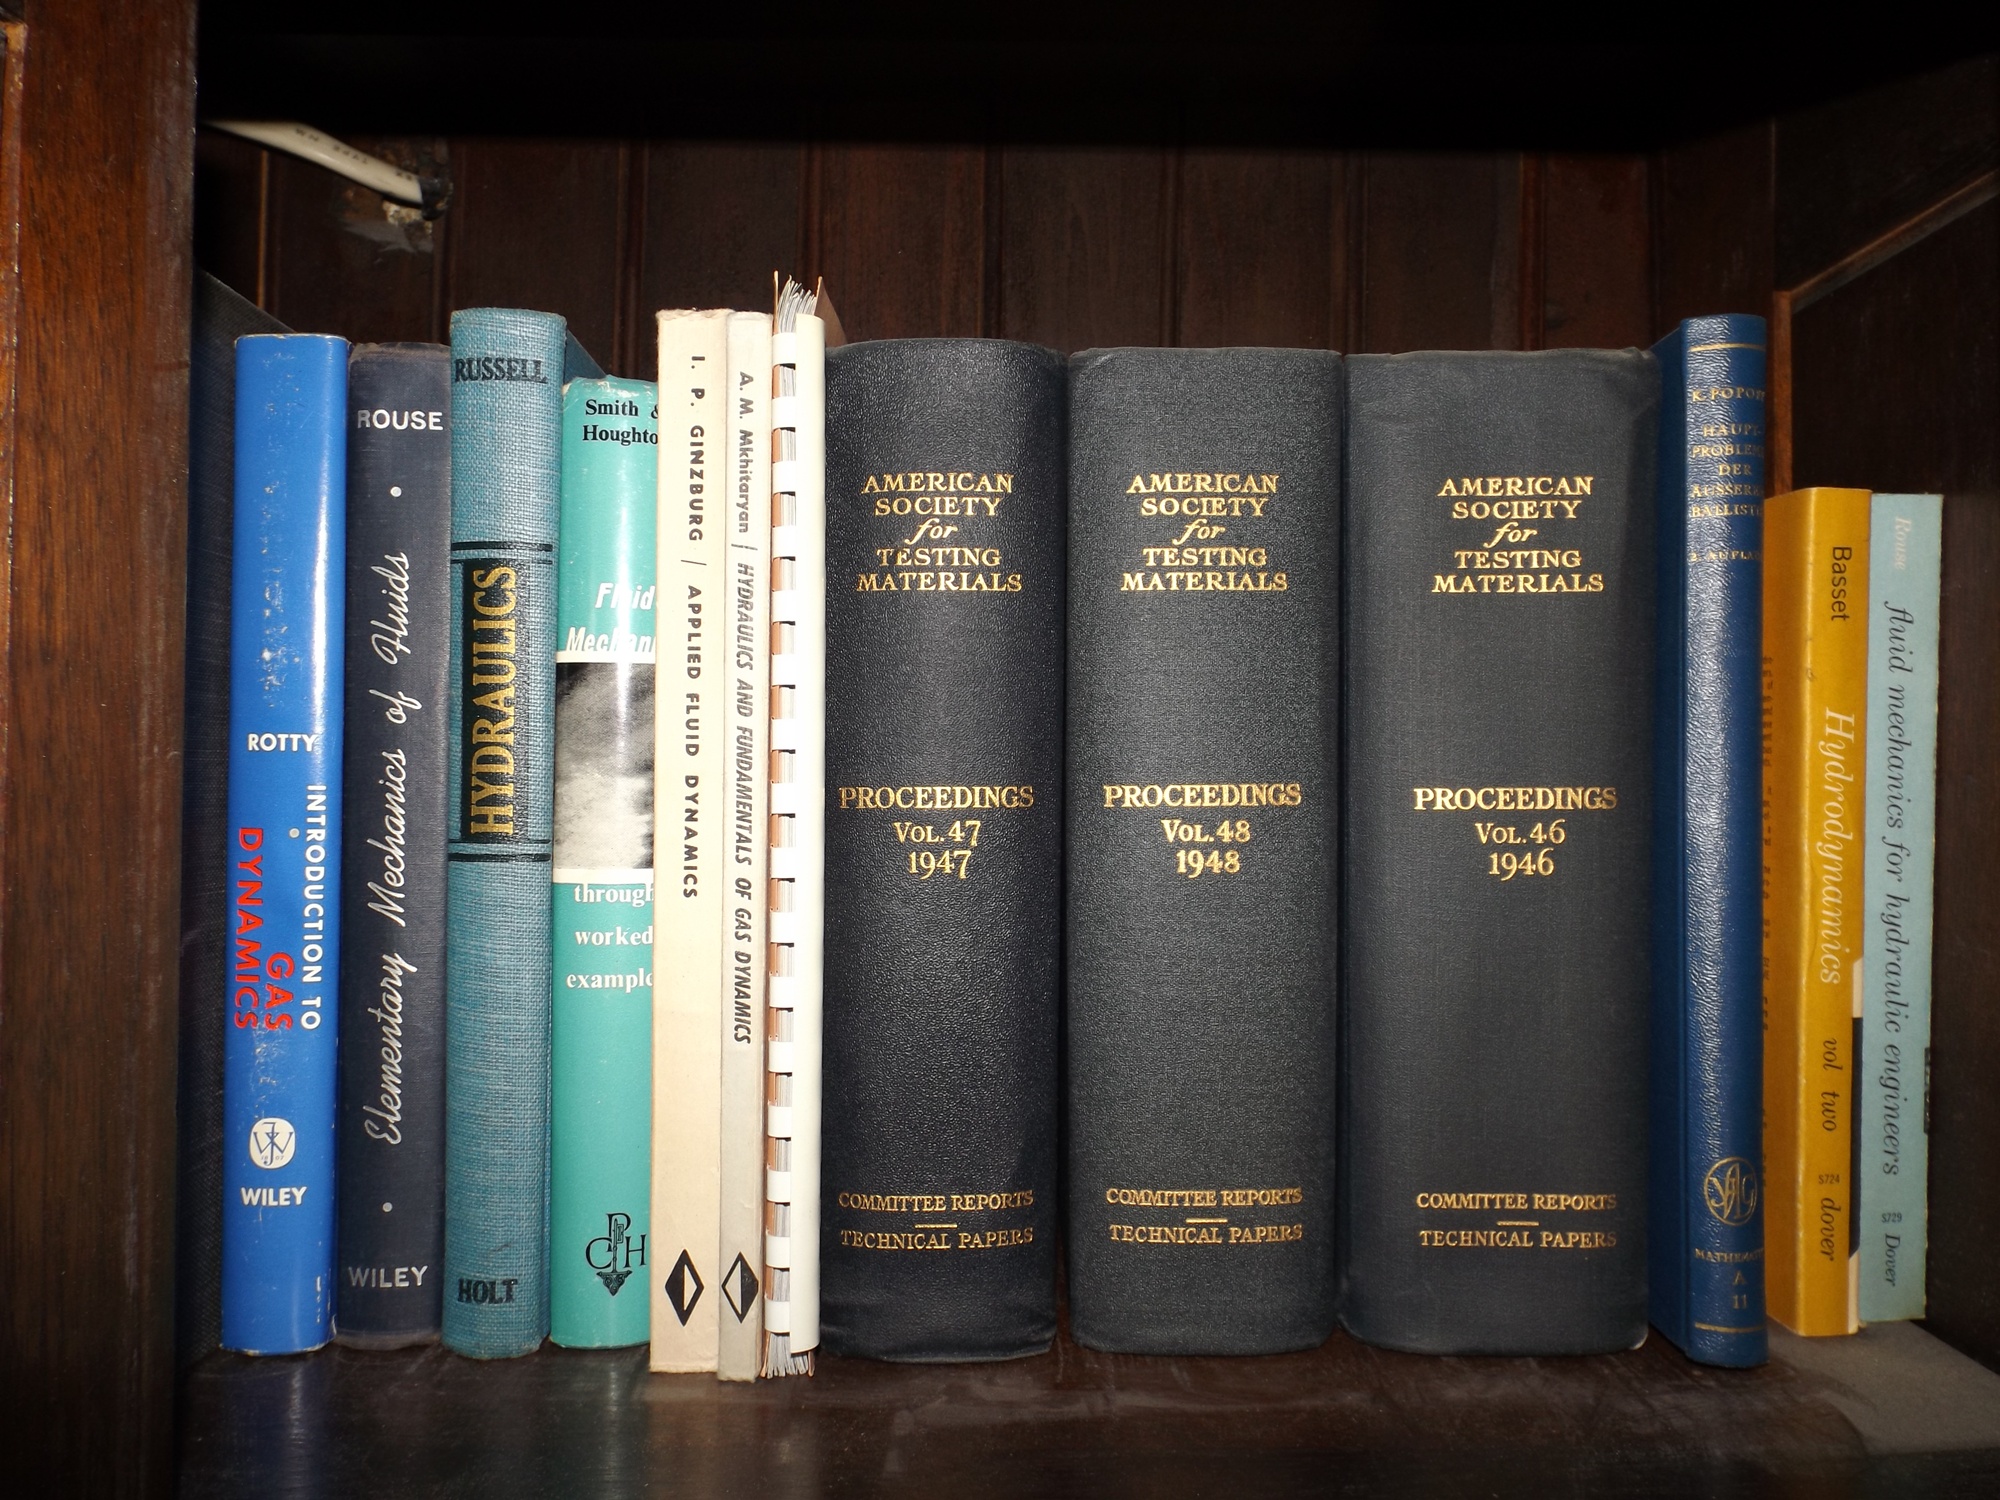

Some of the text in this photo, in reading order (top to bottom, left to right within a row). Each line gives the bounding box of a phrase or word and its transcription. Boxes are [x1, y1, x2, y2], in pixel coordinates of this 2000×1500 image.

[455, 357, 548, 384] RUSSELL
[585, 399, 639, 416] Smith
[357, 409, 444, 430] ROUSE
[738, 371, 754, 534] A. M. Mkhitaryan
[1692, 444, 1765, 458] PROBLEM
[1718, 463, 1752, 476] DER
[688, 425, 705, 541] GINZBURG
[861, 472, 1014, 494] AMERICAN
[1126, 473, 1279, 494] AMERICAN
[1437, 476, 1593, 497] AMERICAN
[874, 496, 1003, 516] SOCIETY
[1141, 497, 1269, 517] SOCIETY
[1452, 500, 1582, 519] SOCIETY
[1691, 503, 1763, 518] BALLISTI
[904, 517, 958, 545] for
[1172, 518, 1225, 545] for
[1483, 521, 1538, 549] for
[1893, 516, 1912, 571] Rouse
[876, 547, 1002, 567] TESTING
[1143, 547, 1268, 567] TESTING
[1454, 550, 1582, 570] TESTING
[856, 571, 1023, 592] MATERIALS
[1120, 571, 1288, 592] MATERIALS
[1432, 573, 1604, 593] MATERIALS
[1831, 546, 1853, 621] Basset
[470, 566, 518, 836] HYDRAULICS
[248, 733, 318, 751] ROTTY
[683, 584, 702, 898] APPLIED FLUID DYNAMICS
[734, 562, 754, 1044] HYDRAULICS AND FUNDAMENTALS OF GAS DYNAMICS
[838, 785, 1034, 809] PROCEEDINGS
[1103, 783, 1302, 808] PROCEEDINGS
[1413, 787, 1618, 810] PROCEEDINGS
[363, 552, 422, 1145] Elementary Mechanics of Fluids
[908, 850, 972, 880] 1947
[1176, 850, 1240, 879] 1948
[1489, 848, 1555, 881] 1946
[1879, 601, 1914, 1175] fluid mechanics for hydraulic engineers
[300, 785, 327, 1029] INTRODUCTION TO
[234, 827, 264, 1029] DYNAMICS
[1817, 707, 1855, 1131] Hydrodynamics vol two
[575, 926, 653, 945] worked
[264, 952, 295, 1030] GAS
[1818, 1174, 1841, 1185] S724
[241, 1186, 307, 1206] WILEY
[838, 1190, 1034, 1212] COMMITTEE REPORTS
[1106, 1187, 1303, 1207] COMMITTEE REPORTS
[1416, 1192, 1618, 1211] COMMITTEE REPORTS
[1881, 1212, 1902, 1223] S729
[840, 1227, 1034, 1250] TECHNICAL PAPERS
[1109, 1223, 1303, 1244] TECHNICAL PAPERS
[1419, 1230, 1618, 1248] TECHNICAL PAPERS
[1820, 1197, 1841, 1261] dover
[1885, 1233, 1901, 1287] Dover
[348, 1265, 429, 1287] WILEY
[1732, 1270, 1747, 1286] A
[458, 1278, 518, 1304] HOLT
